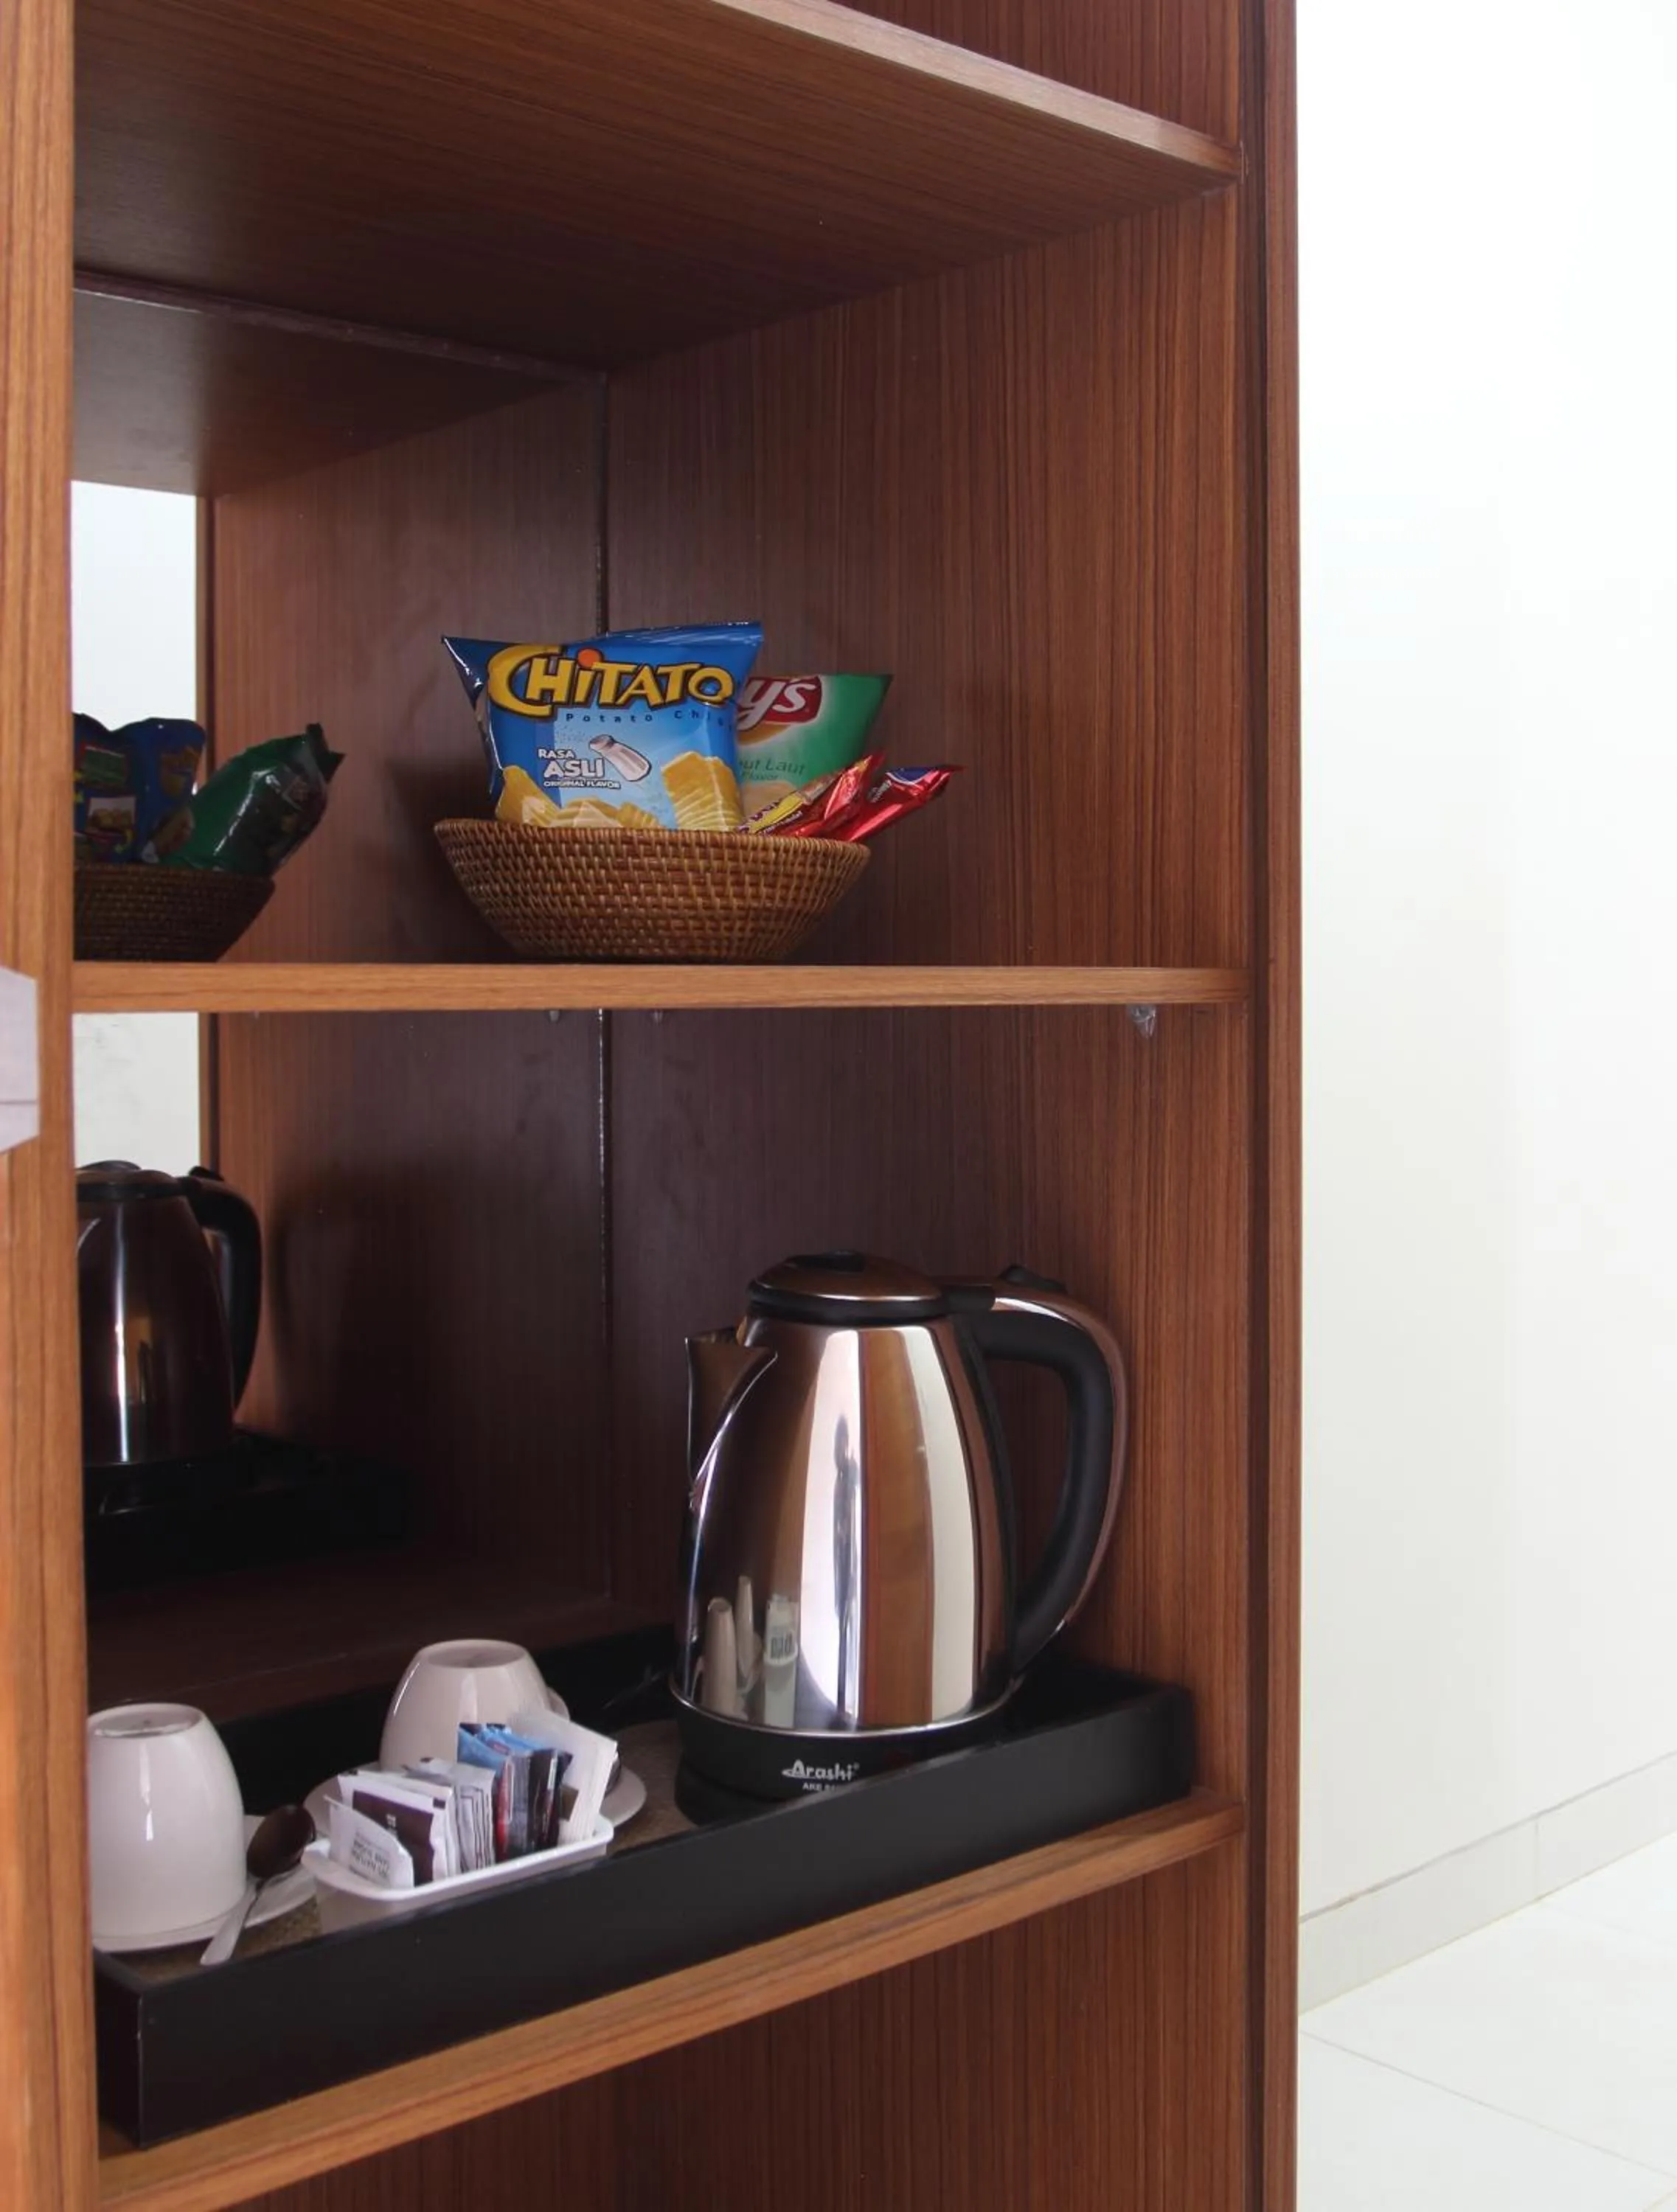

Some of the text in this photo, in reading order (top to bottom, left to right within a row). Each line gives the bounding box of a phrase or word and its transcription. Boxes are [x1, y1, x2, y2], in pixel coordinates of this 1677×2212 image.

[566, 710, 732, 732] Potato Chi
[538, 748, 574, 759] RASA
[544, 759, 604, 779] ASLI
[765, 757, 805, 776] Laut
[587, 780, 620, 788] FLAVOR
[782, 1759, 853, 1781] Arashi
